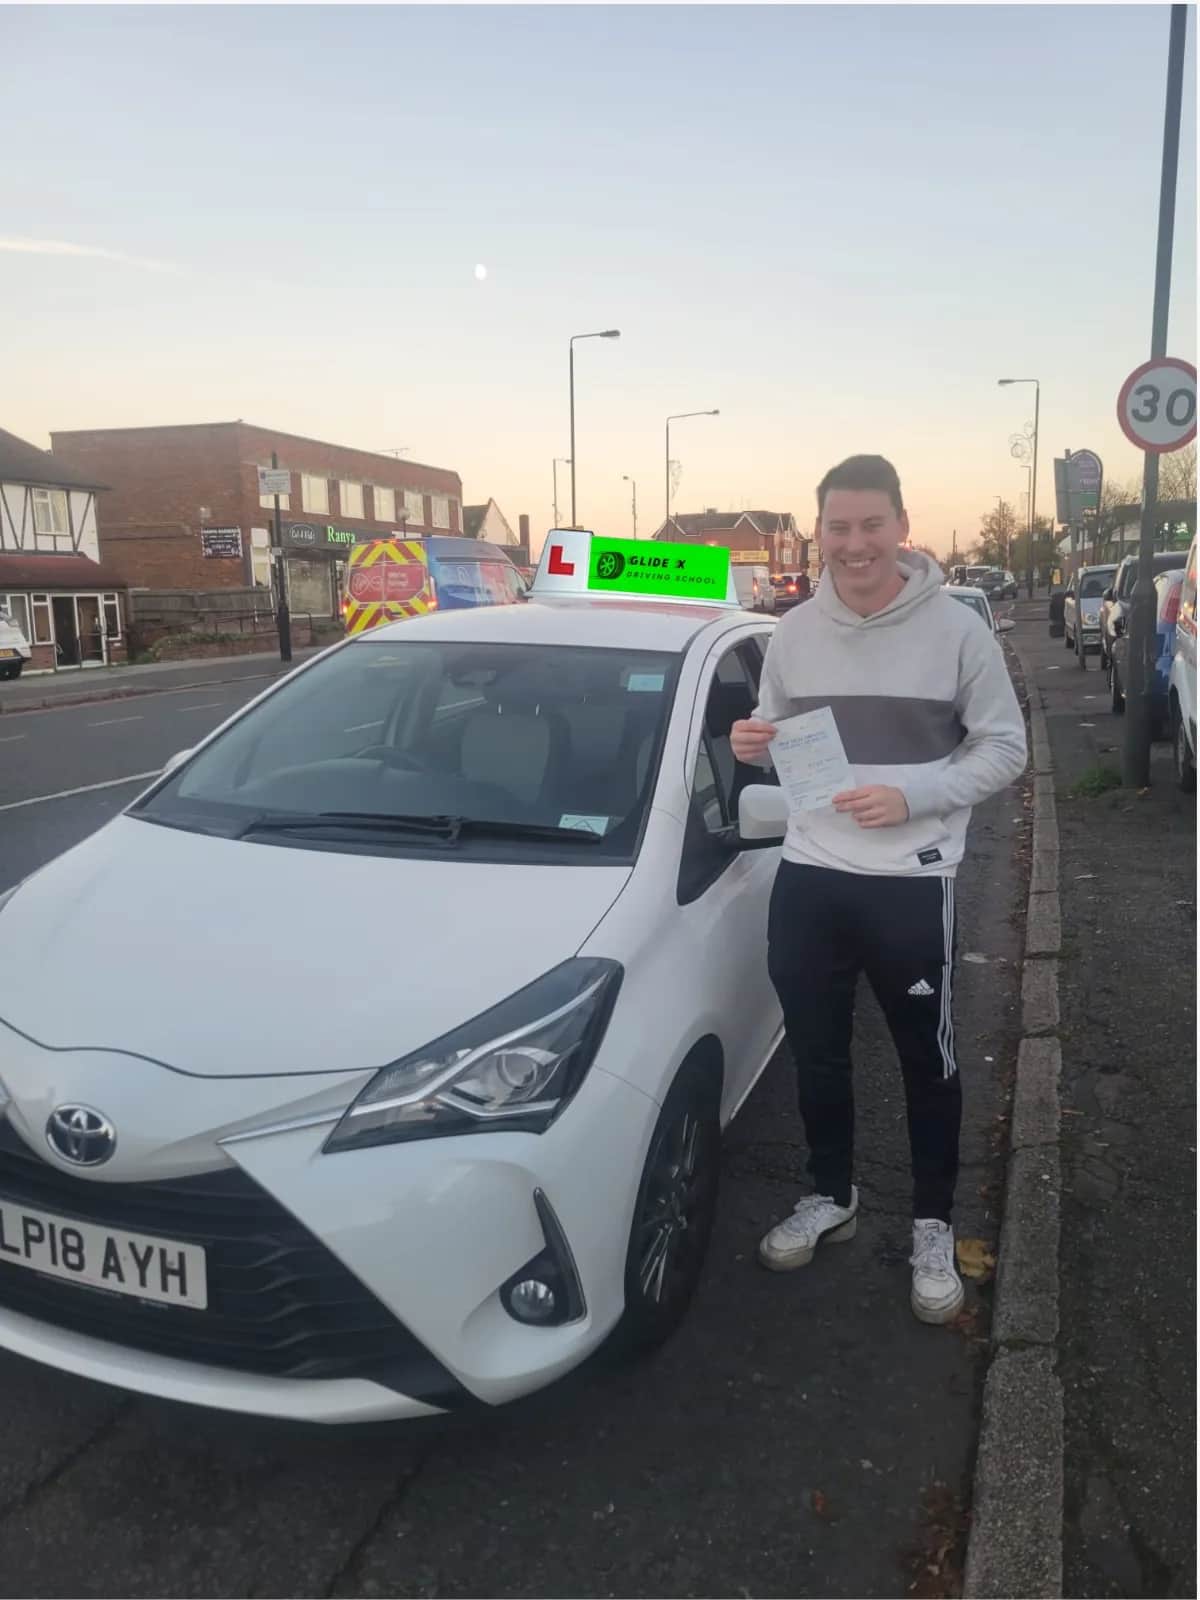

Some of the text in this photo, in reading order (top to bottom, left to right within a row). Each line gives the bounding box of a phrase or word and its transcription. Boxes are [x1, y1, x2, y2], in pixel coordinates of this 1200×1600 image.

[1131, 384, 1197, 426] 30
[327, 525, 356, 546] Ranya
[548, 545, 575, 576] L
[629, 555, 686, 569] GLIDE X
[626, 570, 717, 585] DRIVING SCHOOL
[0, 1208, 188, 1297] LP18 AYH
